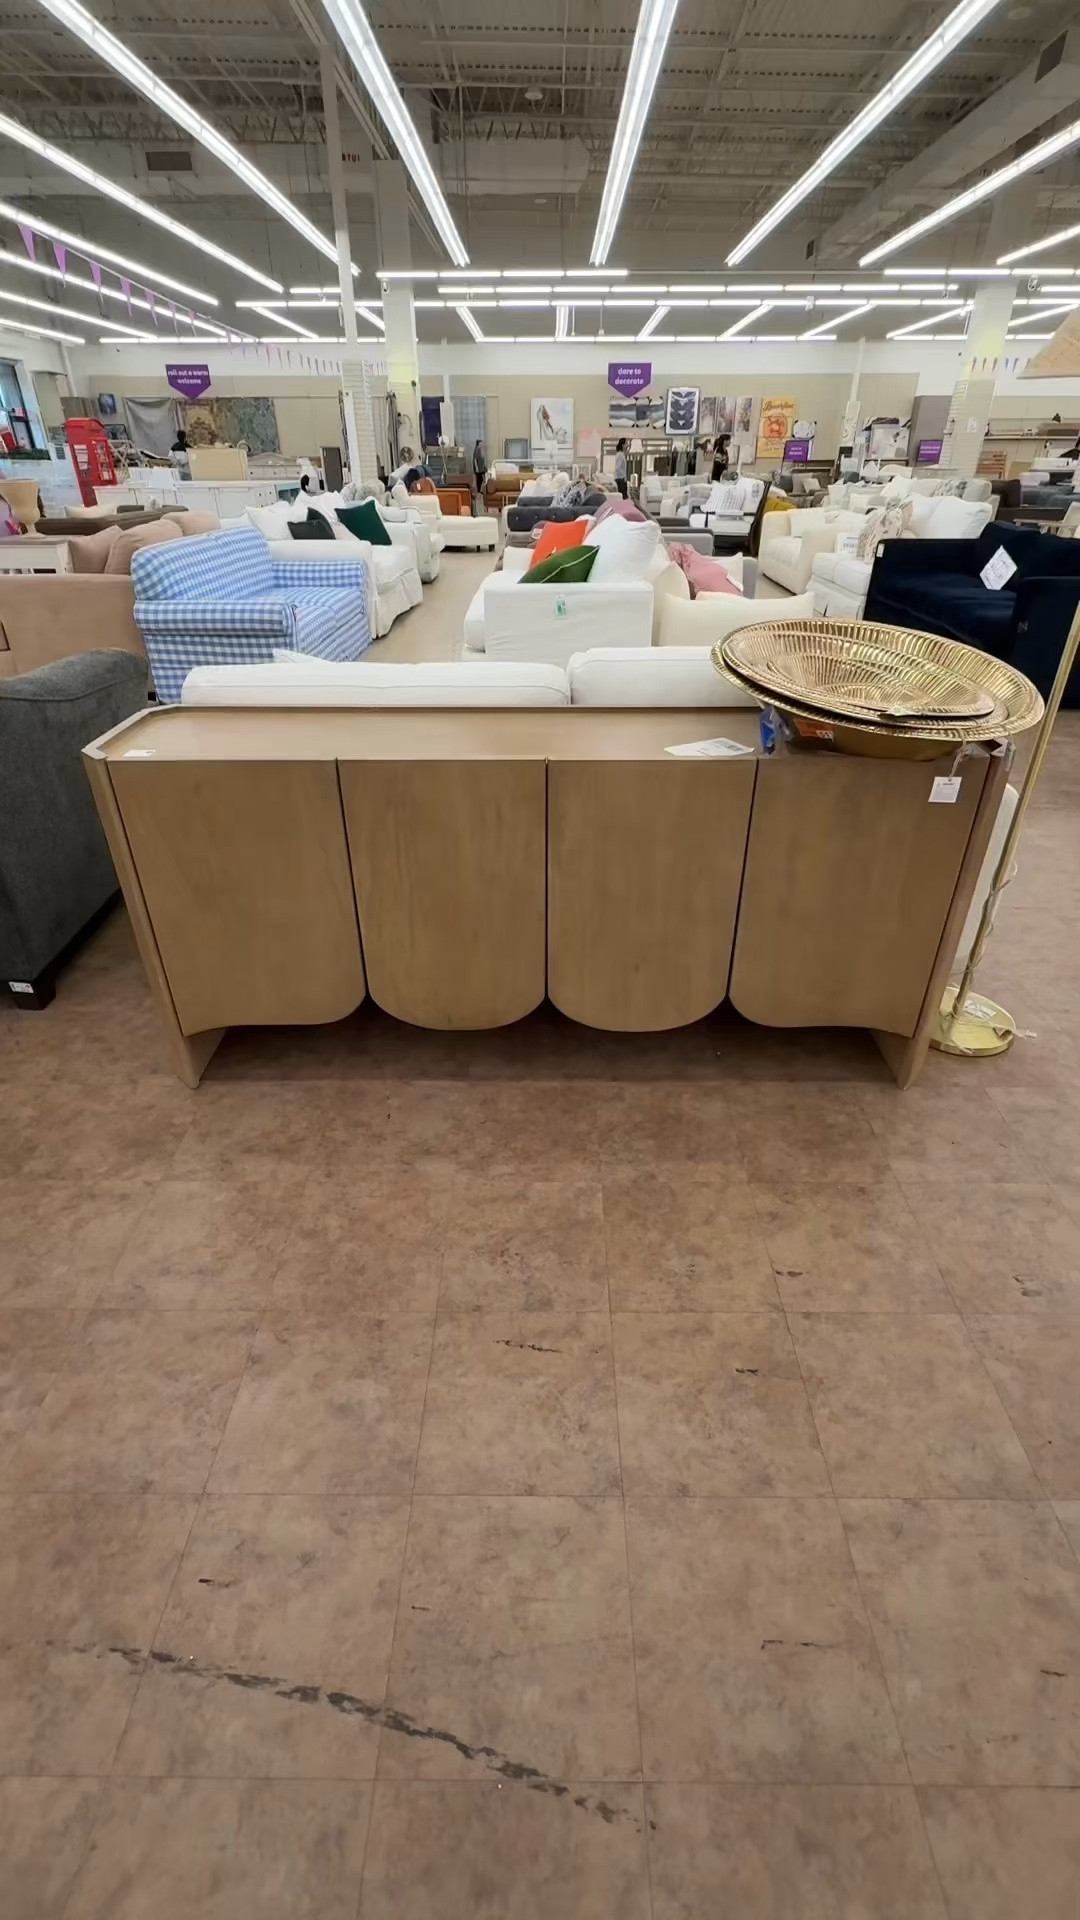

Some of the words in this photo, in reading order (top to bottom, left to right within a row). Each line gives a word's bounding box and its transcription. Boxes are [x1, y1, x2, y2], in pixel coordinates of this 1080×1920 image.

[617, 367, 633, 375] dare
[634, 367, 642, 375] to
[614, 376, 644, 385] decorate
